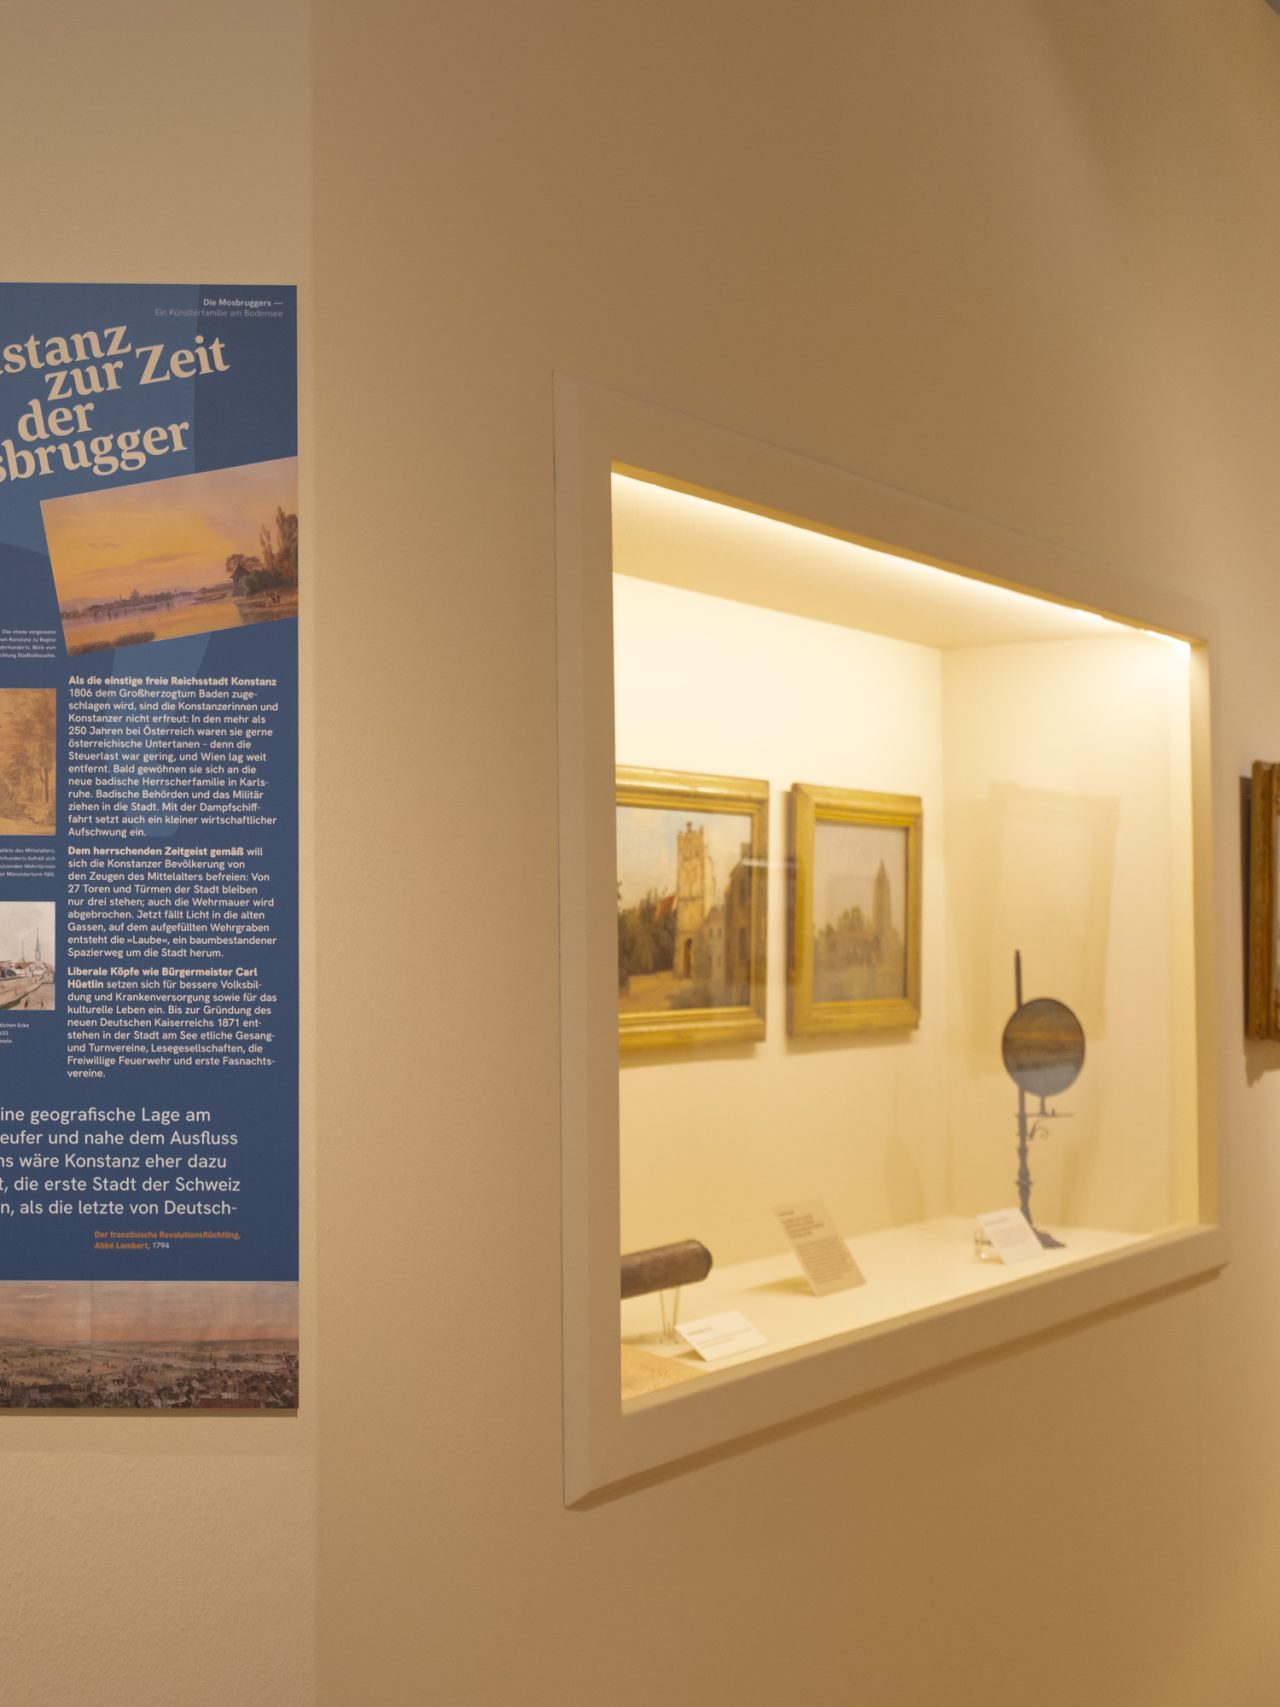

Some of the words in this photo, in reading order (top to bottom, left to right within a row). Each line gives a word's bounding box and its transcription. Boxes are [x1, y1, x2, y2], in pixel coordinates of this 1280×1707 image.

[202, 298, 217, 306] Die
[218, 298, 271, 307] Mosbruggers
[44, 360, 123, 401] zur
[135, 335, 230, 385] Zeit
[17, 398, 95, 442] der
[68, 676, 85, 685] Als
[86, 676, 102, 685] die
[104, 676, 143, 687] einstige
[144, 676, 169, 686] freie
[170, 676, 229, 686] Reichsstadt
[230, 677, 277, 686] Konstanz
[69, 688, 93, 698] 1806
[94, 688, 117, 698] dem
[118, 689, 196, 700] Großherzogtum
[198, 689, 229, 698] Baden
[231, 691, 257, 700] zuge-
[68, 701, 111, 712] schlagen
[112, 701, 136, 712] wird,
[138, 701, 159, 711] sind
[160, 702, 176, 711] die
[178, 702, 258, 711] Konstanzerinnen
[260, 702, 279, 711] und
[94, 777, 139, 786] badische
[142, 777, 225, 787] Herrscherfamilie
[227, 778, 237, 787] in
[239, 778, 269, 787] Karls-
[68, 815, 93, 824] fahrt
[94, 815, 119, 824] setzt
[121, 815, 145, 824] auch
[147, 815, 163, 824] ein
[164, 815, 198, 825] kleiner
[200, 816, 277, 825] wirtschaftlicher
[67, 827, 127, 839] Aufschwung
[129, 828, 147, 837] ein.
[67, 846, 91, 856] Dem
[92, 846, 162, 856] herrschenden
[164, 846, 208, 858] Zeitgeist
[209, 846, 244, 858] gemäß
[246, 847, 263, 856] will
[67, 859, 88, 868] sich
[89, 859, 105, 868] die
[106, 859, 162, 868] Konstanzer
[164, 859, 225, 870] Bevölkerung
[227, 861, 246, 869] von
[67, 872, 87, 881] den
[88, 872, 125, 883] Zeugen
[127, 872, 145, 881] des
[146, 872, 203, 881] Mittelalters
[205, 872, 248, 881] befreien:
[250, 872, 270, 882] Von
[67, 922, 106, 934] Gassen,
[108, 922, 124, 932] auf
[126, 922, 148, 932] dem
[150, 922, 208, 934] aufgefüllten
[209, 923, 270, 934] Wehrgraben
[67, 935, 108, 944] entsteht
[110, 935, 125, 944] die
[172, 935, 187, 944] ein
[188, 935, 277, 945] baumbestandener
[67, 967, 108, 976] Liberale
[110, 967, 140, 978] Köpfe
[142, 967, 159, 976] wie
[161, 967, 233, 978] Bürgermeister
[235, 967, 258, 976] Carl
[67, 979, 104, 989] Hüetlin
[106, 979, 138, 989] setzen
[140, 980, 160, 989] sich
[162, 980, 177, 989] für
[179, 980, 218, 989] bessere
[220, 980, 262, 989] Volksbil-
[67, 992, 92, 1004] dung
[94, 992, 113, 1002] und
[115, 992, 210, 1004] Krankenversorgung
[212, 993, 240, 1002] sowie
[242, 993, 257, 1002] für
[259, 993, 277, 1002] das
[99, 1018, 152, 1027] Deutschen
[154, 1018, 214, 1027] Kaiserreichs
[217, 1018, 239, 1027] 1871
[242, 1018, 262, 1027] ent-
[66, 1043, 86, 1052] und
[88, 1043, 148, 1054] Turnvereine,
[150, 1043, 246, 1055] Lesegesellschaften,
[247, 1044, 263, 1053] die
[66, 1056, 116, 1067] Freiwillige
[118, 1056, 171, 1065] Feuerwehr
[173, 1056, 192, 1065] und
[194, 1056, 220, 1066] erste
[222, 1056, 276, 1066] Fasnachts-
[66, 1068, 106, 1078] vereine.
[30, 1108, 136, 1125] geografische
[141, 1108, 180, 1125] Lage
[185, 1111, 211, 1122] am
[48, 1131, 79, 1145] und
[84, 1131, 124, 1145] nahe
[129, 1131, 165, 1145] dem
[170, 1131, 238, 1146] Ausfluss
[19, 1154, 59, 1168] wäre
[64, 1154, 140, 1168] Konstanz
[144, 1154, 182, 1169] eher
[187, 1154, 227, 1169] dazu
[13, 1177, 39, 1192] die
[44, 1177, 87, 1192] erste
[92, 1178, 136, 1192] Stadt
[142, 1178, 170, 1192] der
[175, 1178, 241, 1192] Schweiz
[19, 1201, 43, 1215] als
[48, 1201, 73, 1215] die
[78, 1201, 124, 1215] letzte
[129, 1204, 159, 1215] von
[164, 1201, 237, 1215] Deutsch-
